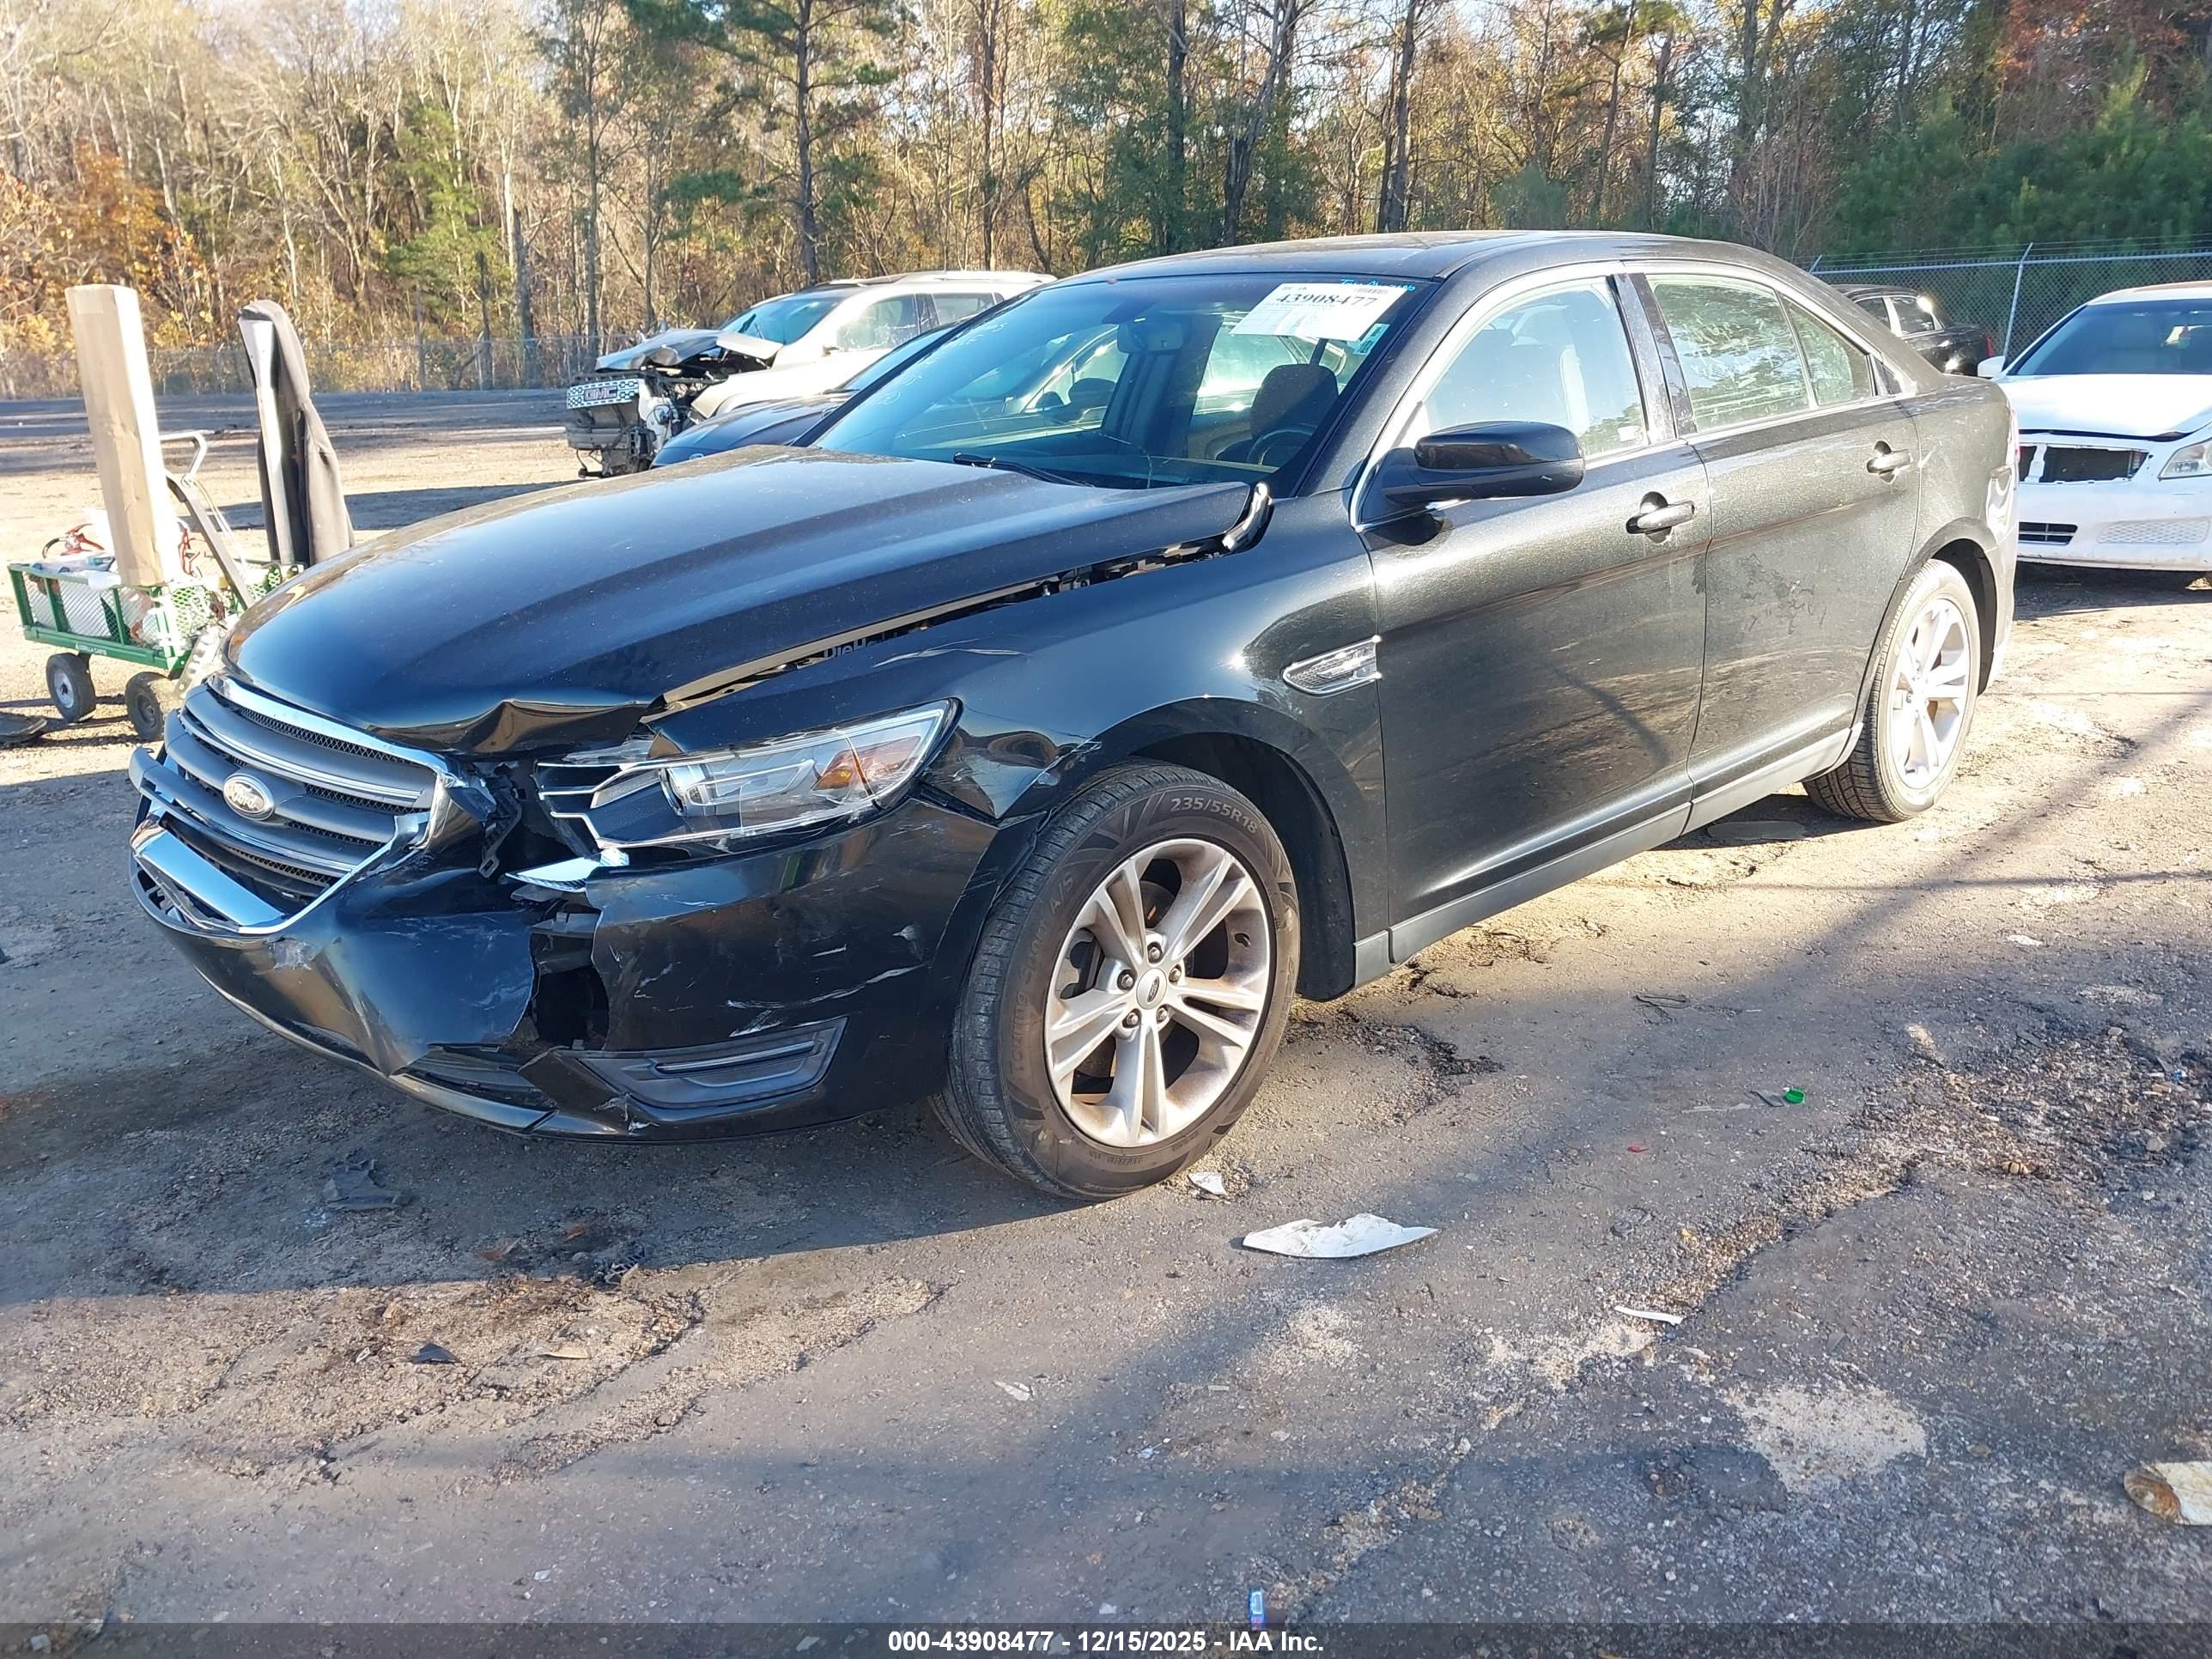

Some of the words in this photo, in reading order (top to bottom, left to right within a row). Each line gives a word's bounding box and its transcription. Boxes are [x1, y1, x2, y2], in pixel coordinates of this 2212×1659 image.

[1277, 294, 1378, 307] 43908477
[586, 386, 617, 401] GMC
[824, 632, 885, 659] DieH
[1170, 797, 1258, 834] 235/55R18
